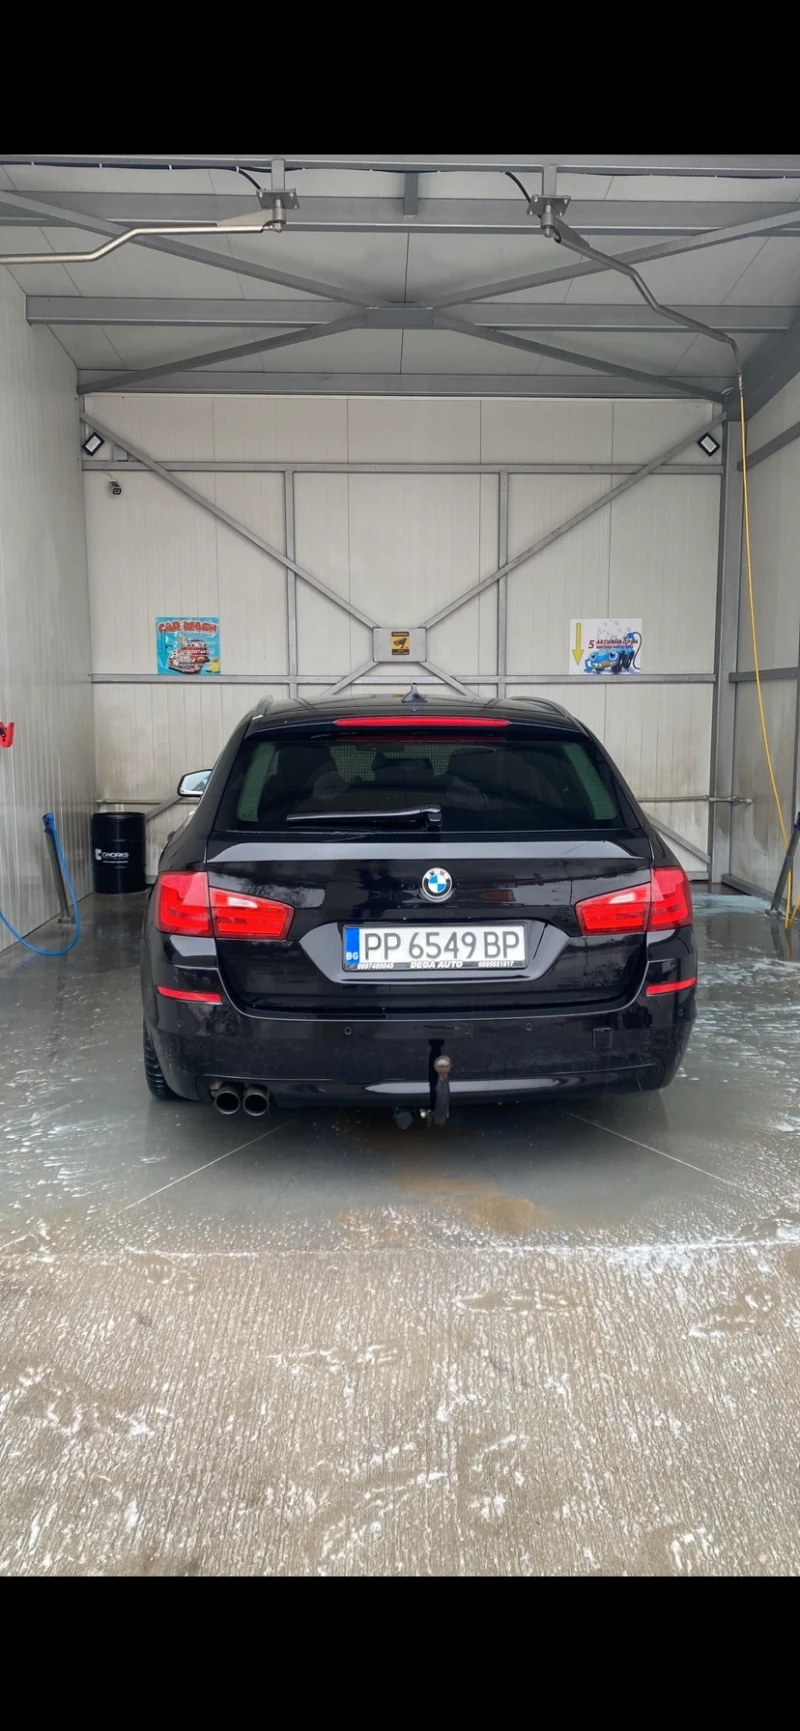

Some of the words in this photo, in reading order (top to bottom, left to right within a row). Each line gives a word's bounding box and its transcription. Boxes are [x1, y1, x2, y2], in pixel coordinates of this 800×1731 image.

[588, 640, 595, 649] 5
[364, 932, 401, 960] PP
[408, 931, 477, 960] 6549
[484, 931, 520, 958] BP
[346, 951, 359, 960] BG
[410, 961, 436, 969] DEGA
[437, 960, 463, 968] AUTO
